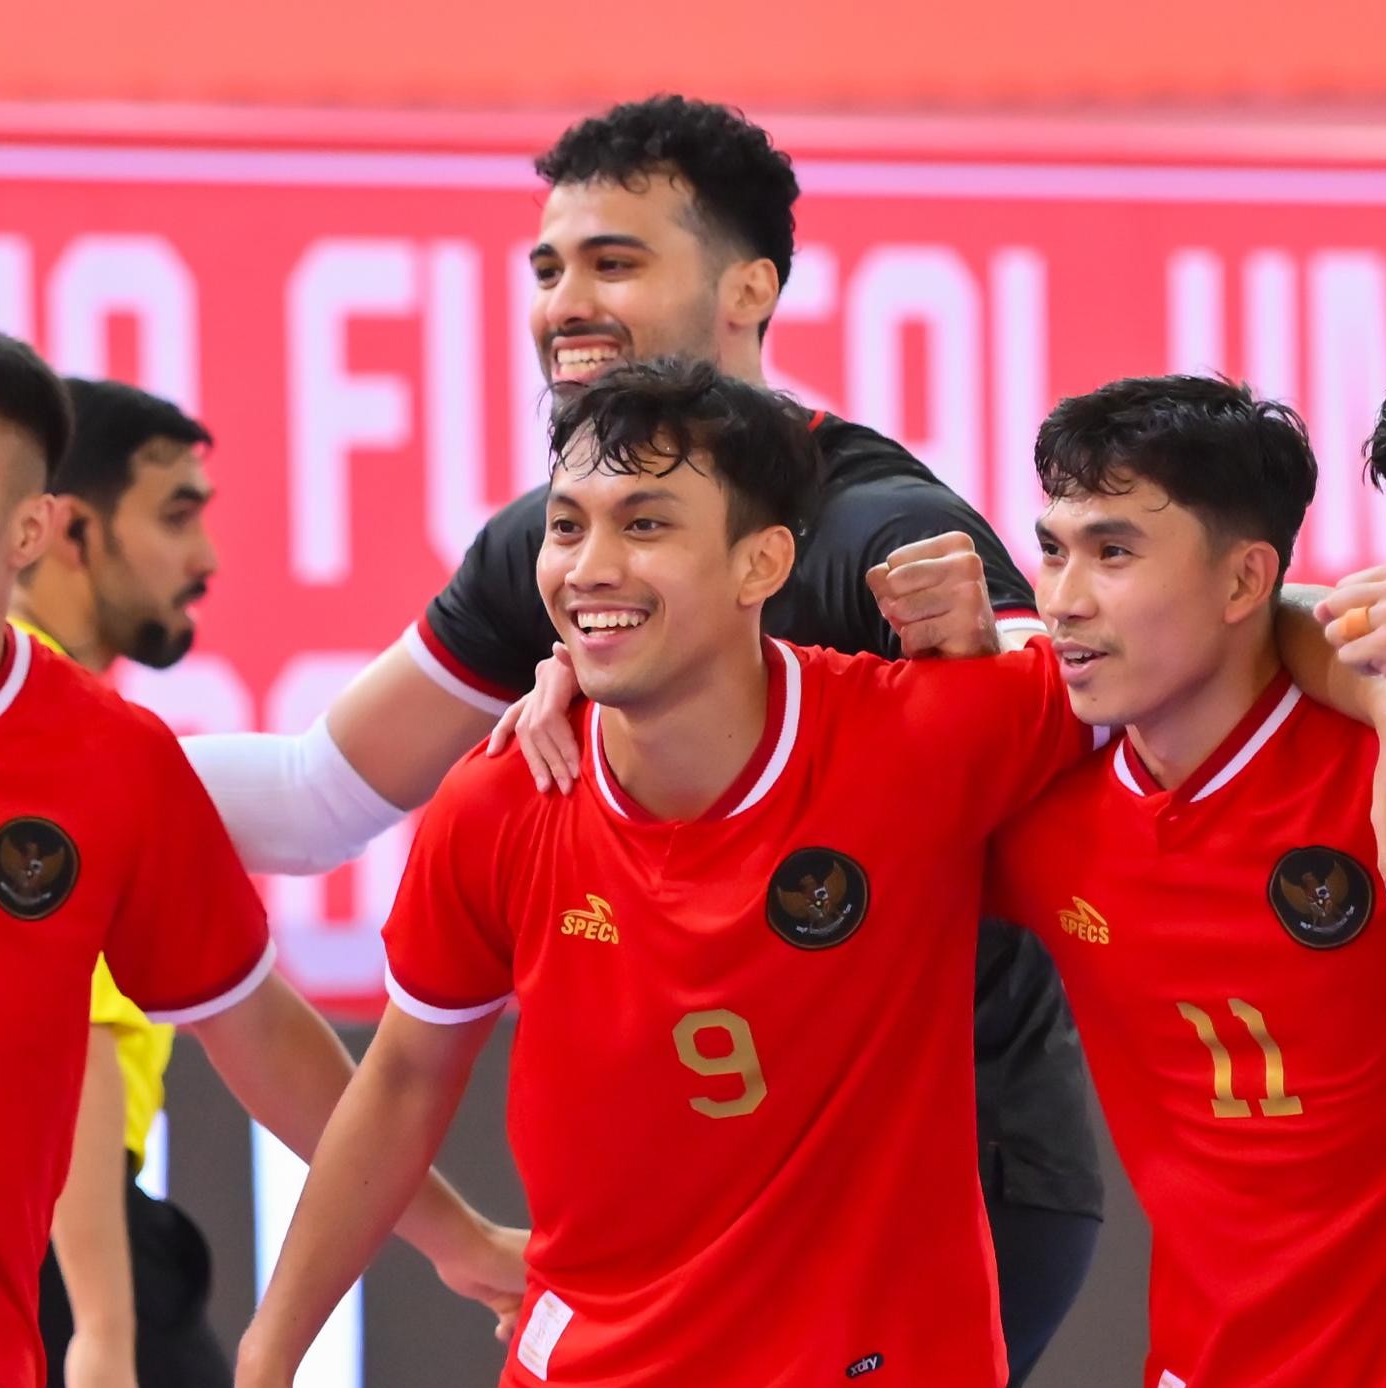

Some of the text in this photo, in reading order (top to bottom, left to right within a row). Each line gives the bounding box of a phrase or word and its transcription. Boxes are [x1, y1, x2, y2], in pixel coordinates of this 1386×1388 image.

[561, 915, 619, 944] SPECS
[1060, 915, 1110, 945] SPECS
[672, 1008, 768, 1119] 9
[1176, 998, 1303, 1119] 11
